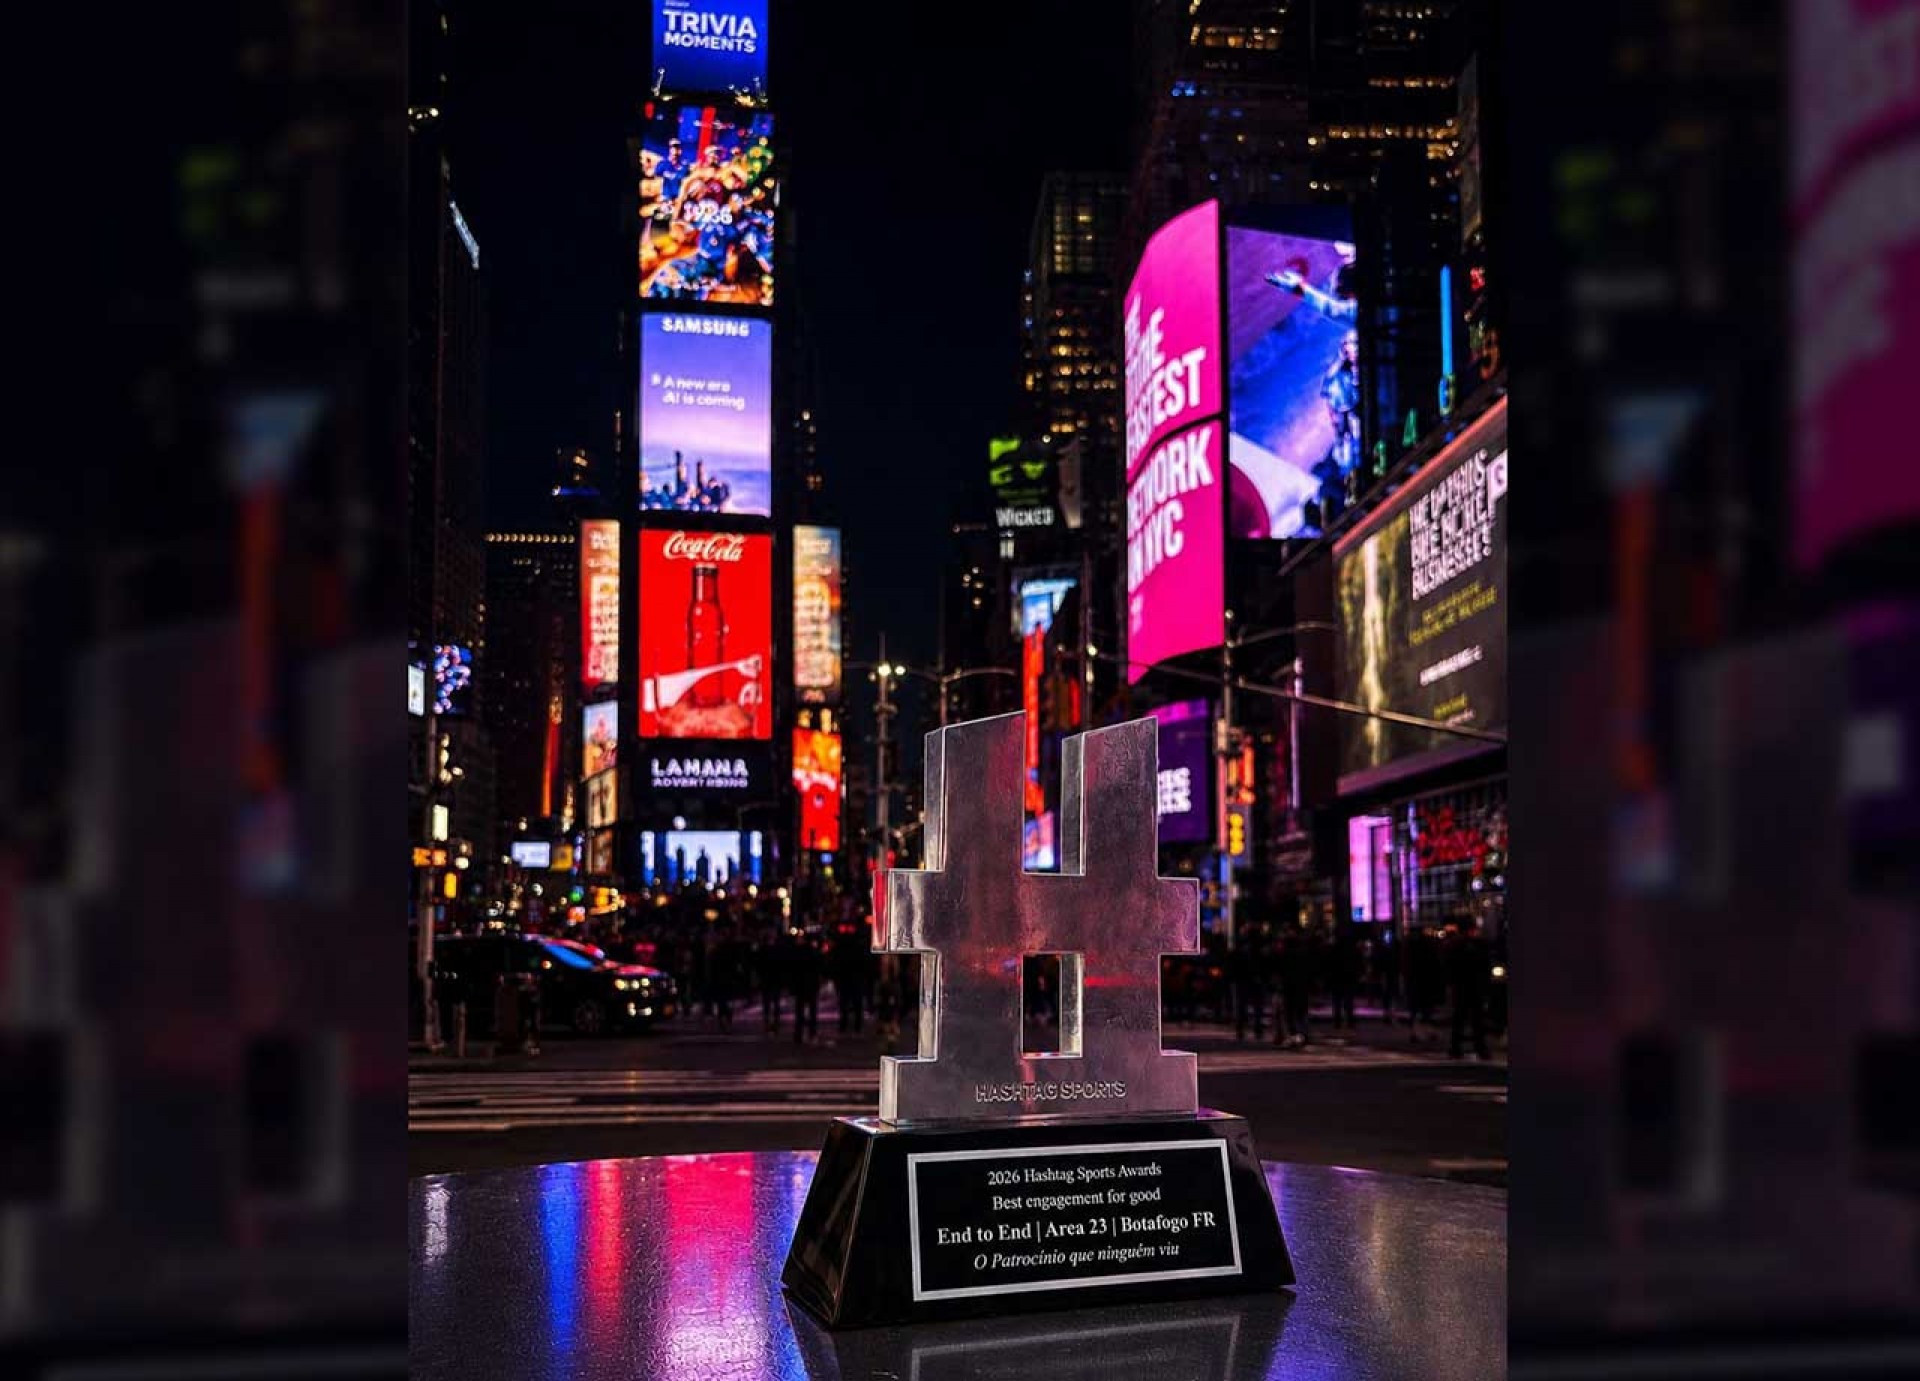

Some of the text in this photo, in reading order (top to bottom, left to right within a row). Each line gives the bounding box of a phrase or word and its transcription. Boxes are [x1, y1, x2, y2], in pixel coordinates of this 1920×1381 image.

[662, 9, 757, 39] TRIVIA
[663, 32, 757, 53] MOMENTS
[662, 317, 750, 337] SAMSUNG
[696, 396, 745, 411] coming
[975, 1080, 1126, 1102] HASHTAG SPORTS
[987, 1162, 1162, 1185] 2026 Hashtag Sports Awards
[993, 1187, 1161, 1210] Best engagement for good
[937, 1226, 972, 1245] End
[977, 1228, 994, 1242] to
[998, 1223, 1031, 1241] End
[1045, 1221, 1085, 1237] Area
[1089, 1218, 1107, 1235] 23
[1121, 1214, 1188, 1233] Botafogo
[1192, 1211, 1216, 1228] FR
[974, 1242, 1180, 1270] O Patrocínio que ninguém viu
